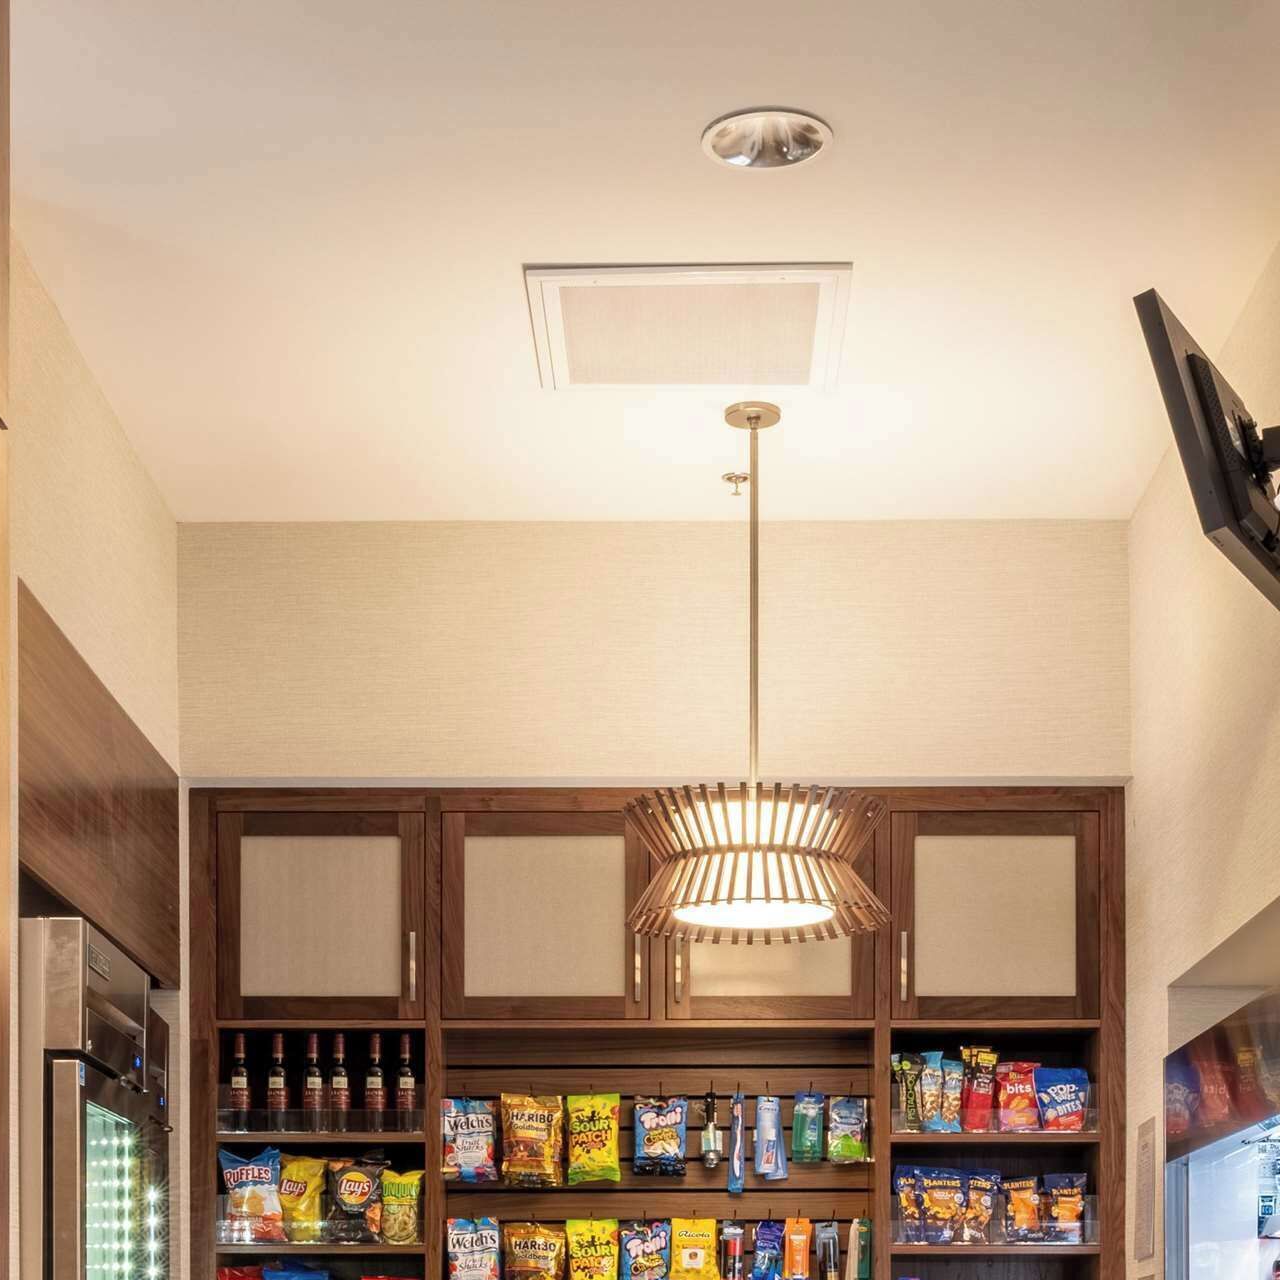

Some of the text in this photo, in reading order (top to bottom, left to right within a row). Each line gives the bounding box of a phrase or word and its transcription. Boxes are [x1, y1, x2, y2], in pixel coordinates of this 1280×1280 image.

[1006, 1083, 1032, 1094] bits
[1056, 1100, 1082, 1116] BITES
[447, 1116, 492, 1132] Welch's
[511, 1111, 553, 1123] HARIBO
[572, 1119, 610, 1131] SOUR
[641, 1107, 682, 1129] Trolli
[572, 1130, 611, 1144] PATCH
[224, 1166, 272, 1188] RUFFLES
[281, 1180, 306, 1196] Lay's
[341, 1179, 371, 1195] Lay's
[448, 1234, 497, 1250] Welch's
[678, 1230, 711, 1238] Ricola
[513, 1240, 556, 1252] HARIBO
[571, 1246, 611, 1257] SOUR
[626, 1231, 667, 1258] Trolli
